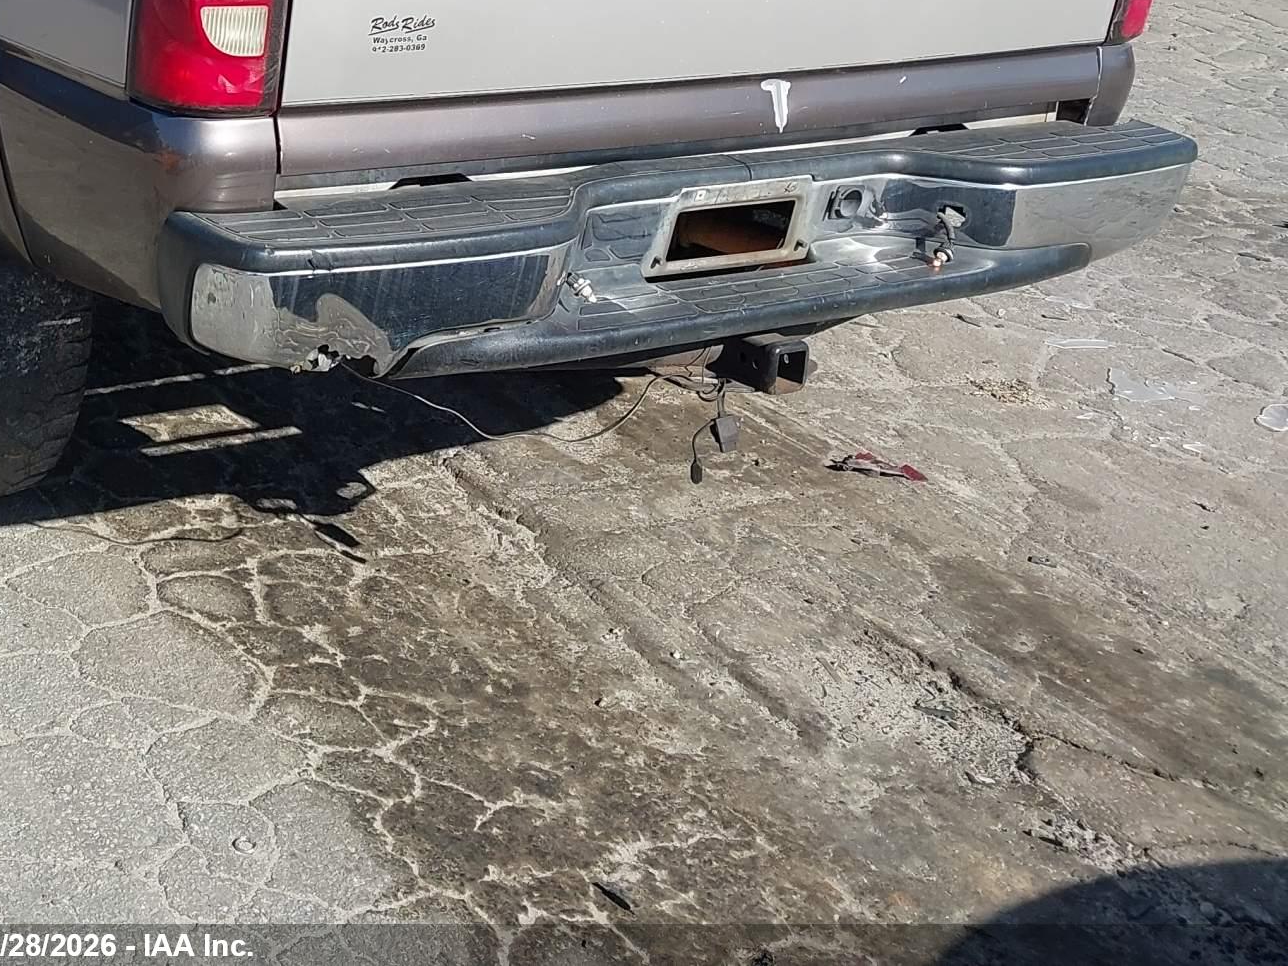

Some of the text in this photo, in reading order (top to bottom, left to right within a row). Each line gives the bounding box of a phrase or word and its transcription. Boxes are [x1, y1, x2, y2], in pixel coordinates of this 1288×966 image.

[369, 15, 436, 35] Rods Rides
[416, 34, 428, 42] Ga
